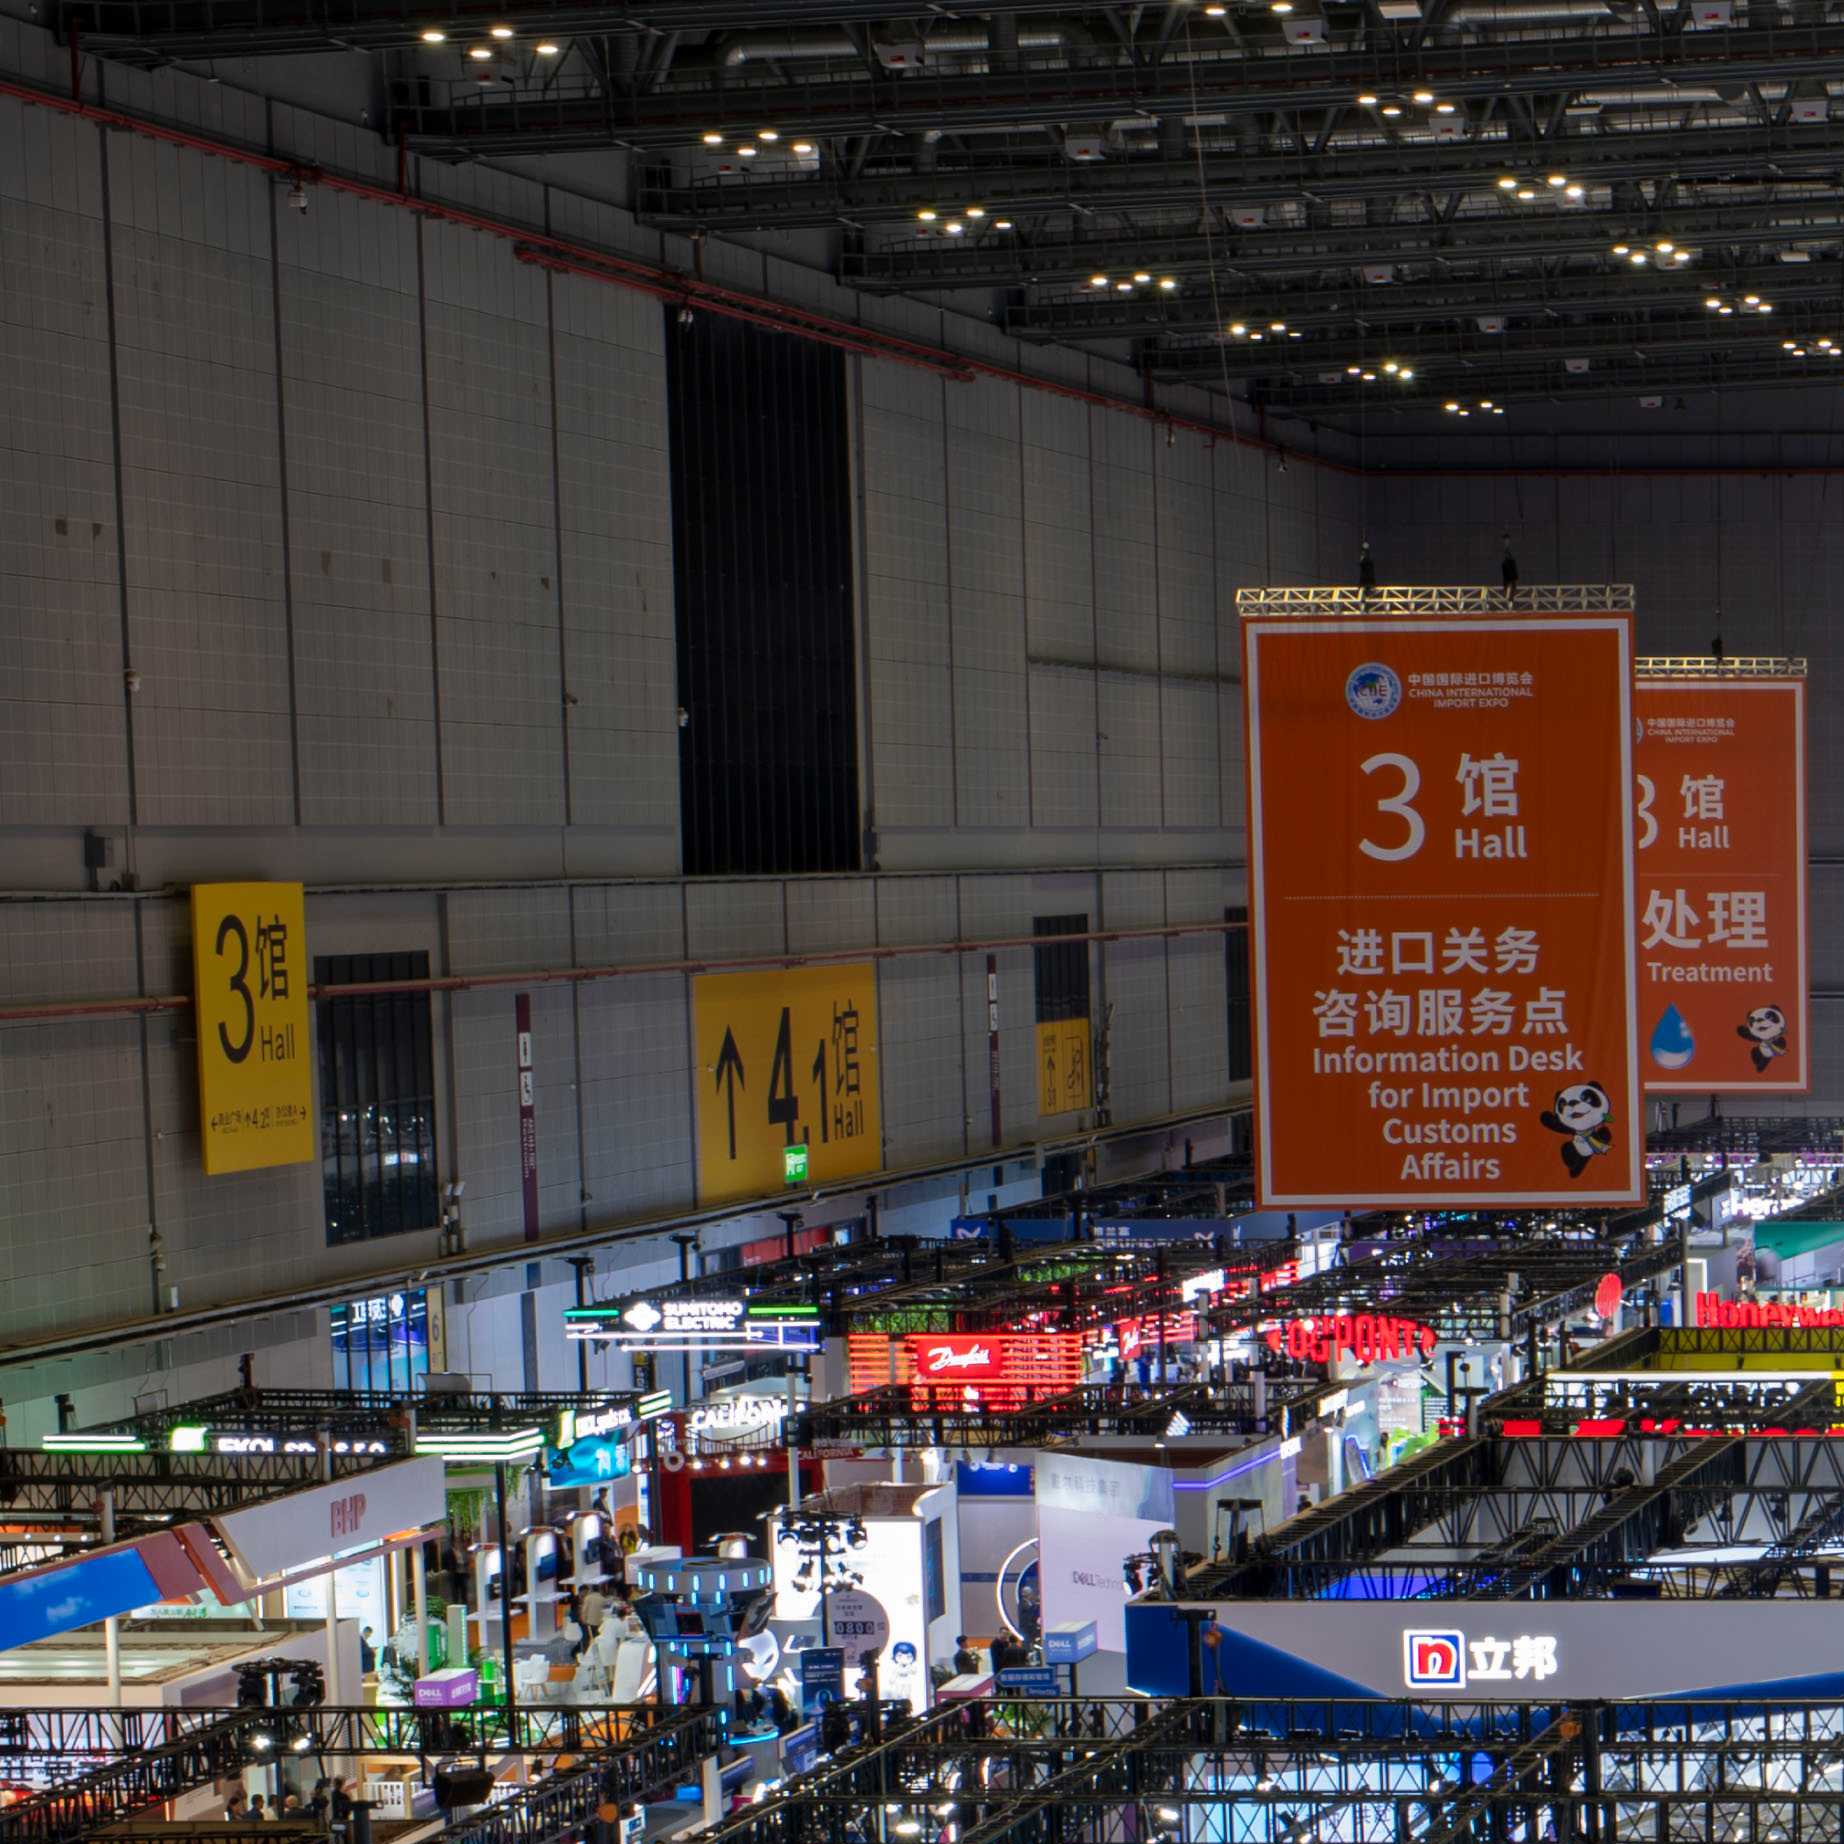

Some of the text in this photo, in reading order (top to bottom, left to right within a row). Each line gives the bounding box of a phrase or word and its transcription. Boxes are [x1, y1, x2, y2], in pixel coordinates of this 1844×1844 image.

[1408, 671, 1533, 687] 中国国际进口博览会
[1409, 686, 1533, 698] CHINA INTERNATIONAL
[1434, 697, 1509, 708] IMPORT EXPO
[1358, 753, 1519, 861] 3 馆
[1680, 775, 1724, 819] 馆
[1455, 826, 1528, 859] Hall
[1678, 826, 1730, 850] Hall
[1336, 927, 1540, 976] 进口关务
[1647, 961, 1773, 983] Treatment
[214, 914, 288, 1064] 3 馆
[1313, 987, 1568, 1037] 咨询服务点
[261, 1022, 295, 1062] Hall
[768, 1000, 860, 1145] 4.1 馆
[1313, 1044, 1583, 1074] Information Desk
[1368, 1081, 1529, 1112] for Import
[834, 1100, 864, 1143] Hall
[1383, 1117, 1517, 1145] Customs
[1400, 1152, 1500, 1180] Affairs
[663, 1303, 743, 1316] SUMITOMO
[664, 1317, 736, 1330] ELECTRIC
[331, 1493, 368, 1538] BHP
[1467, 1636, 1558, 1680] 立邦
